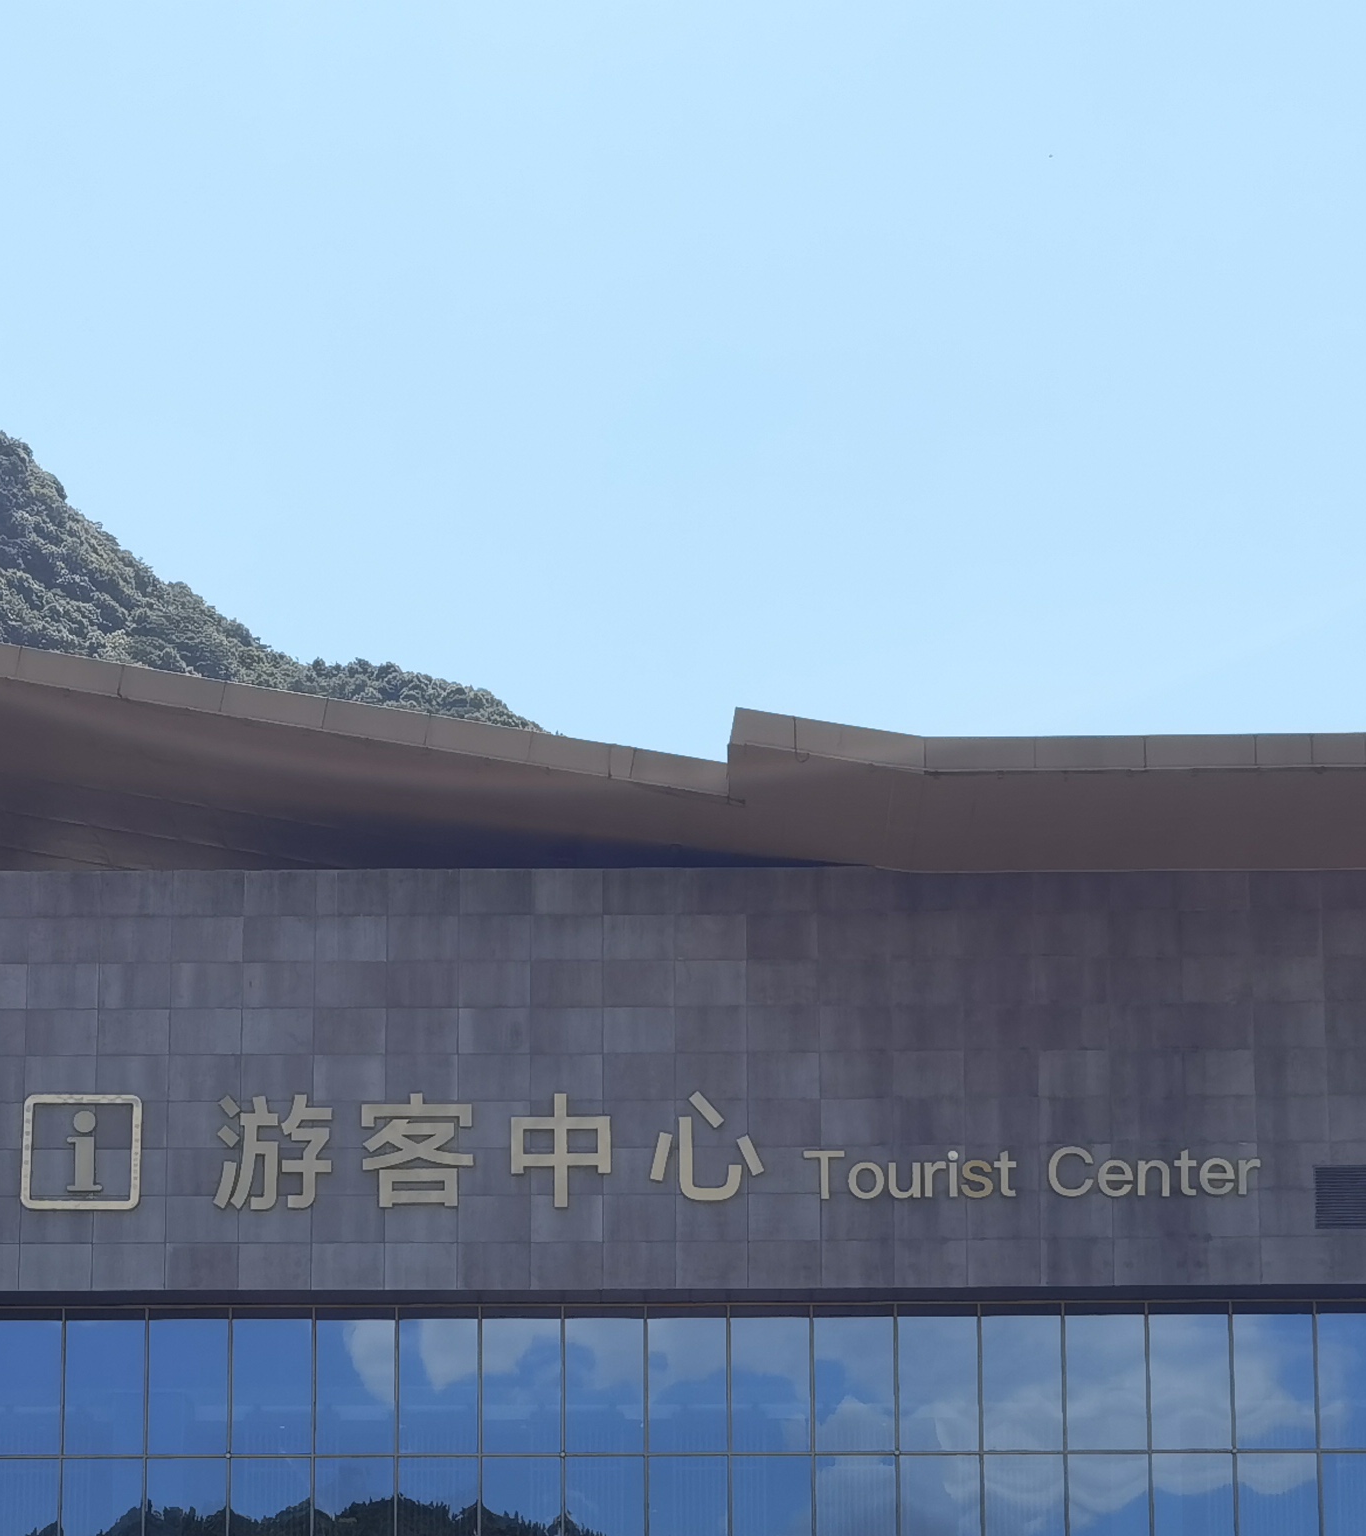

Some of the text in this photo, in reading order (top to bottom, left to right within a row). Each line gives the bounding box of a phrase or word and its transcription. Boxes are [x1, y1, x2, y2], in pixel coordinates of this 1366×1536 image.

[212, 1091, 765, 1212] 游客中心
[802, 1145, 1262, 1200] Tourist Center
